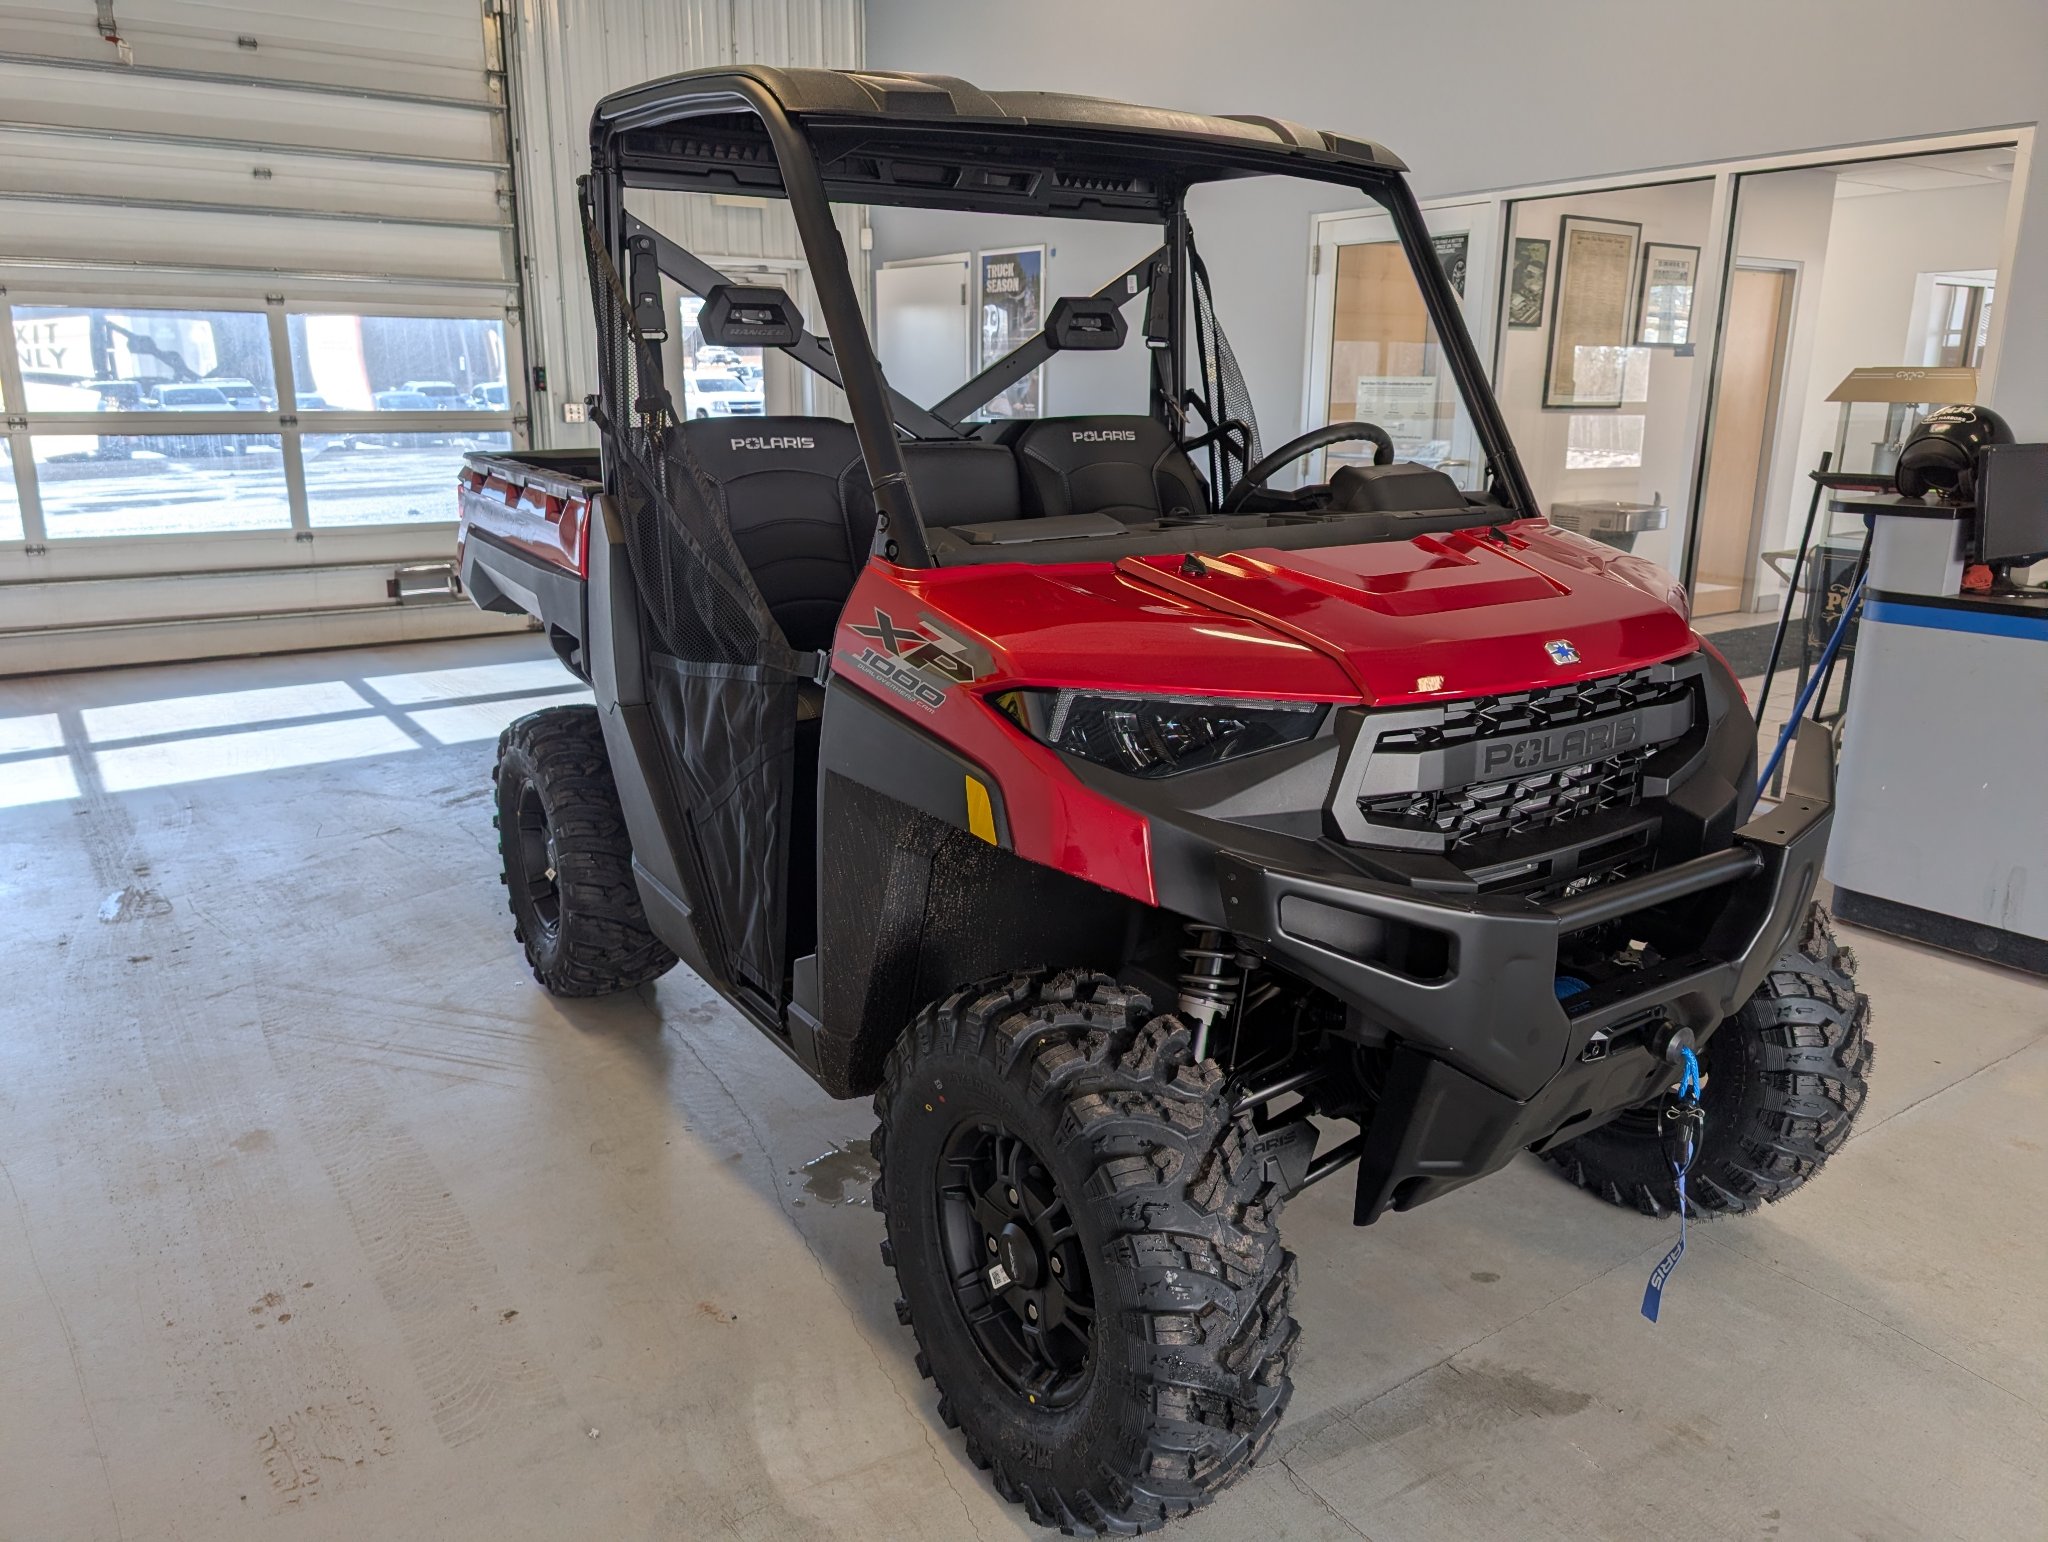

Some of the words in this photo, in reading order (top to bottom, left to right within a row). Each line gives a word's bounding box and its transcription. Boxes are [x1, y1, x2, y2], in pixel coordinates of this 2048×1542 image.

[987, 262, 1015, 279] TRUCK
[986, 277, 1020, 293] SEASON
[16, 322, 59, 344] XIT
[19, 347, 68, 369] NLY
[731, 437, 815, 450] POLARIS
[1072, 430, 1136, 443] POLARIS
[846, 606, 975, 684] XP
[854, 646, 947, 709] 1000
[875, 675, 917, 702] OVERHEAD
[1484, 717, 1637, 774] POLARIS
[1252, 1131, 1297, 1155] ARIS
[1651, 1241, 1683, 1291] ARIS
